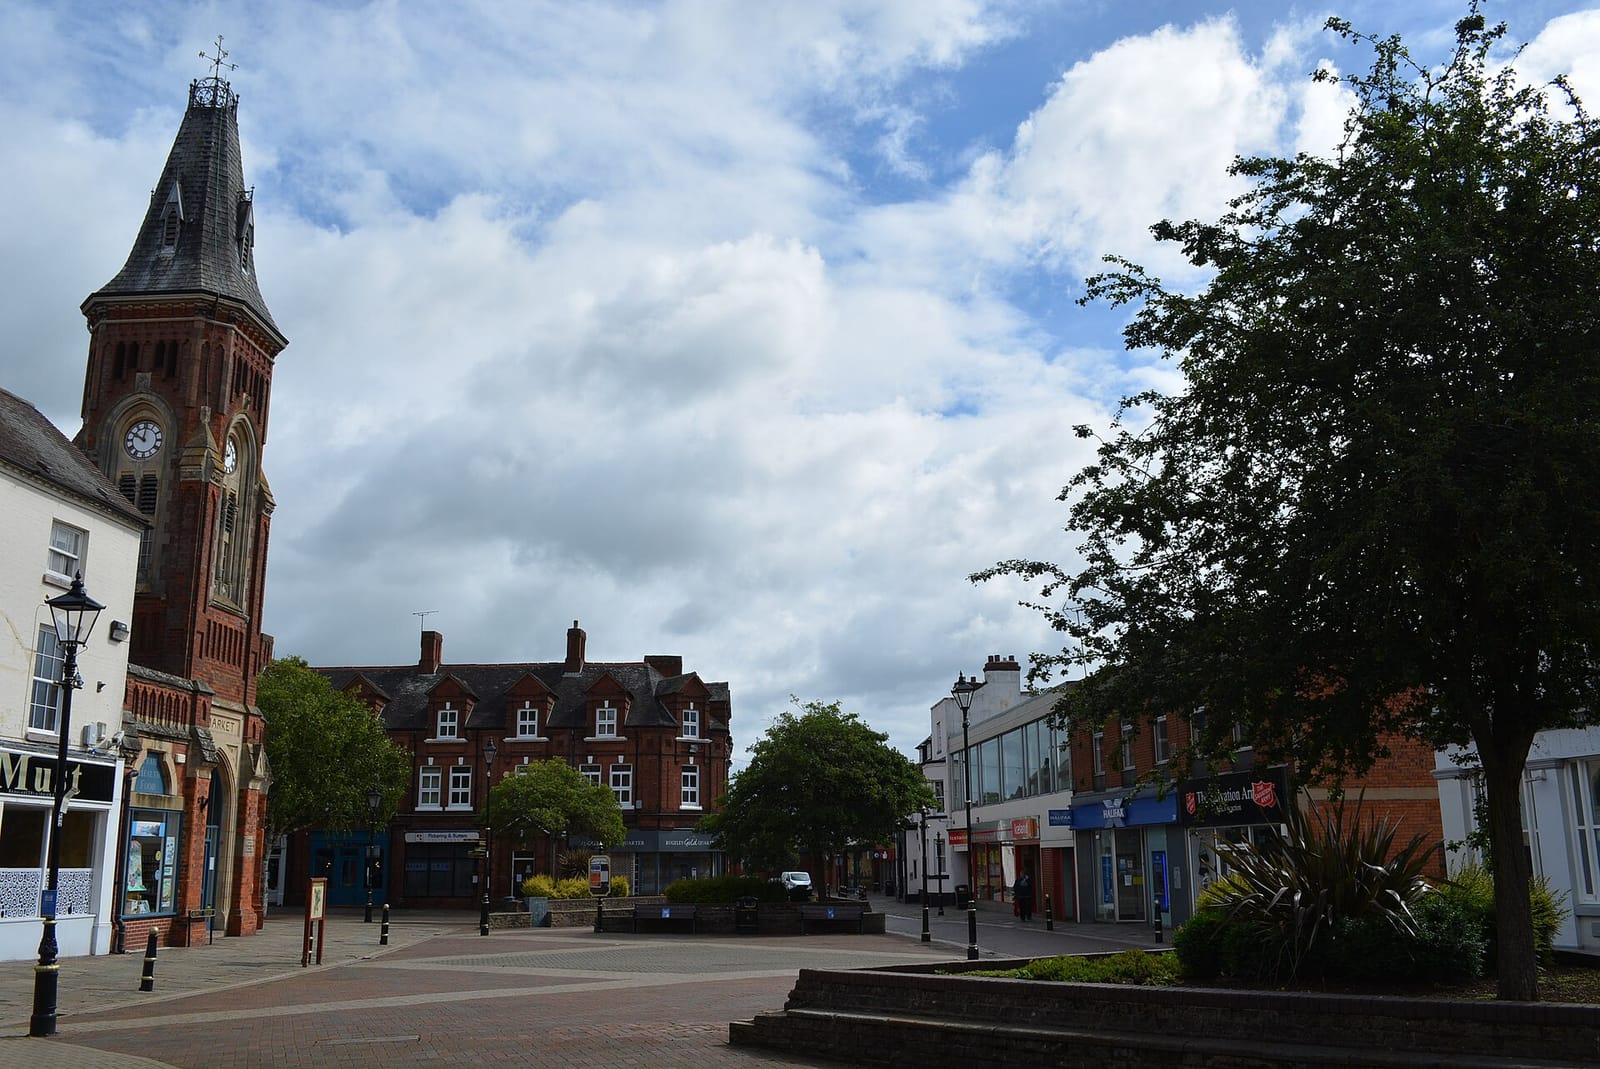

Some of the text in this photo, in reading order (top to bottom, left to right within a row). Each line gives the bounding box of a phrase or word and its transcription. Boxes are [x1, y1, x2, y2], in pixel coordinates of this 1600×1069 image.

[212, 717, 235, 733] ARKET
[0, 752, 82, 793] Mut
[1103, 808, 1125, 819] HALIFAX
